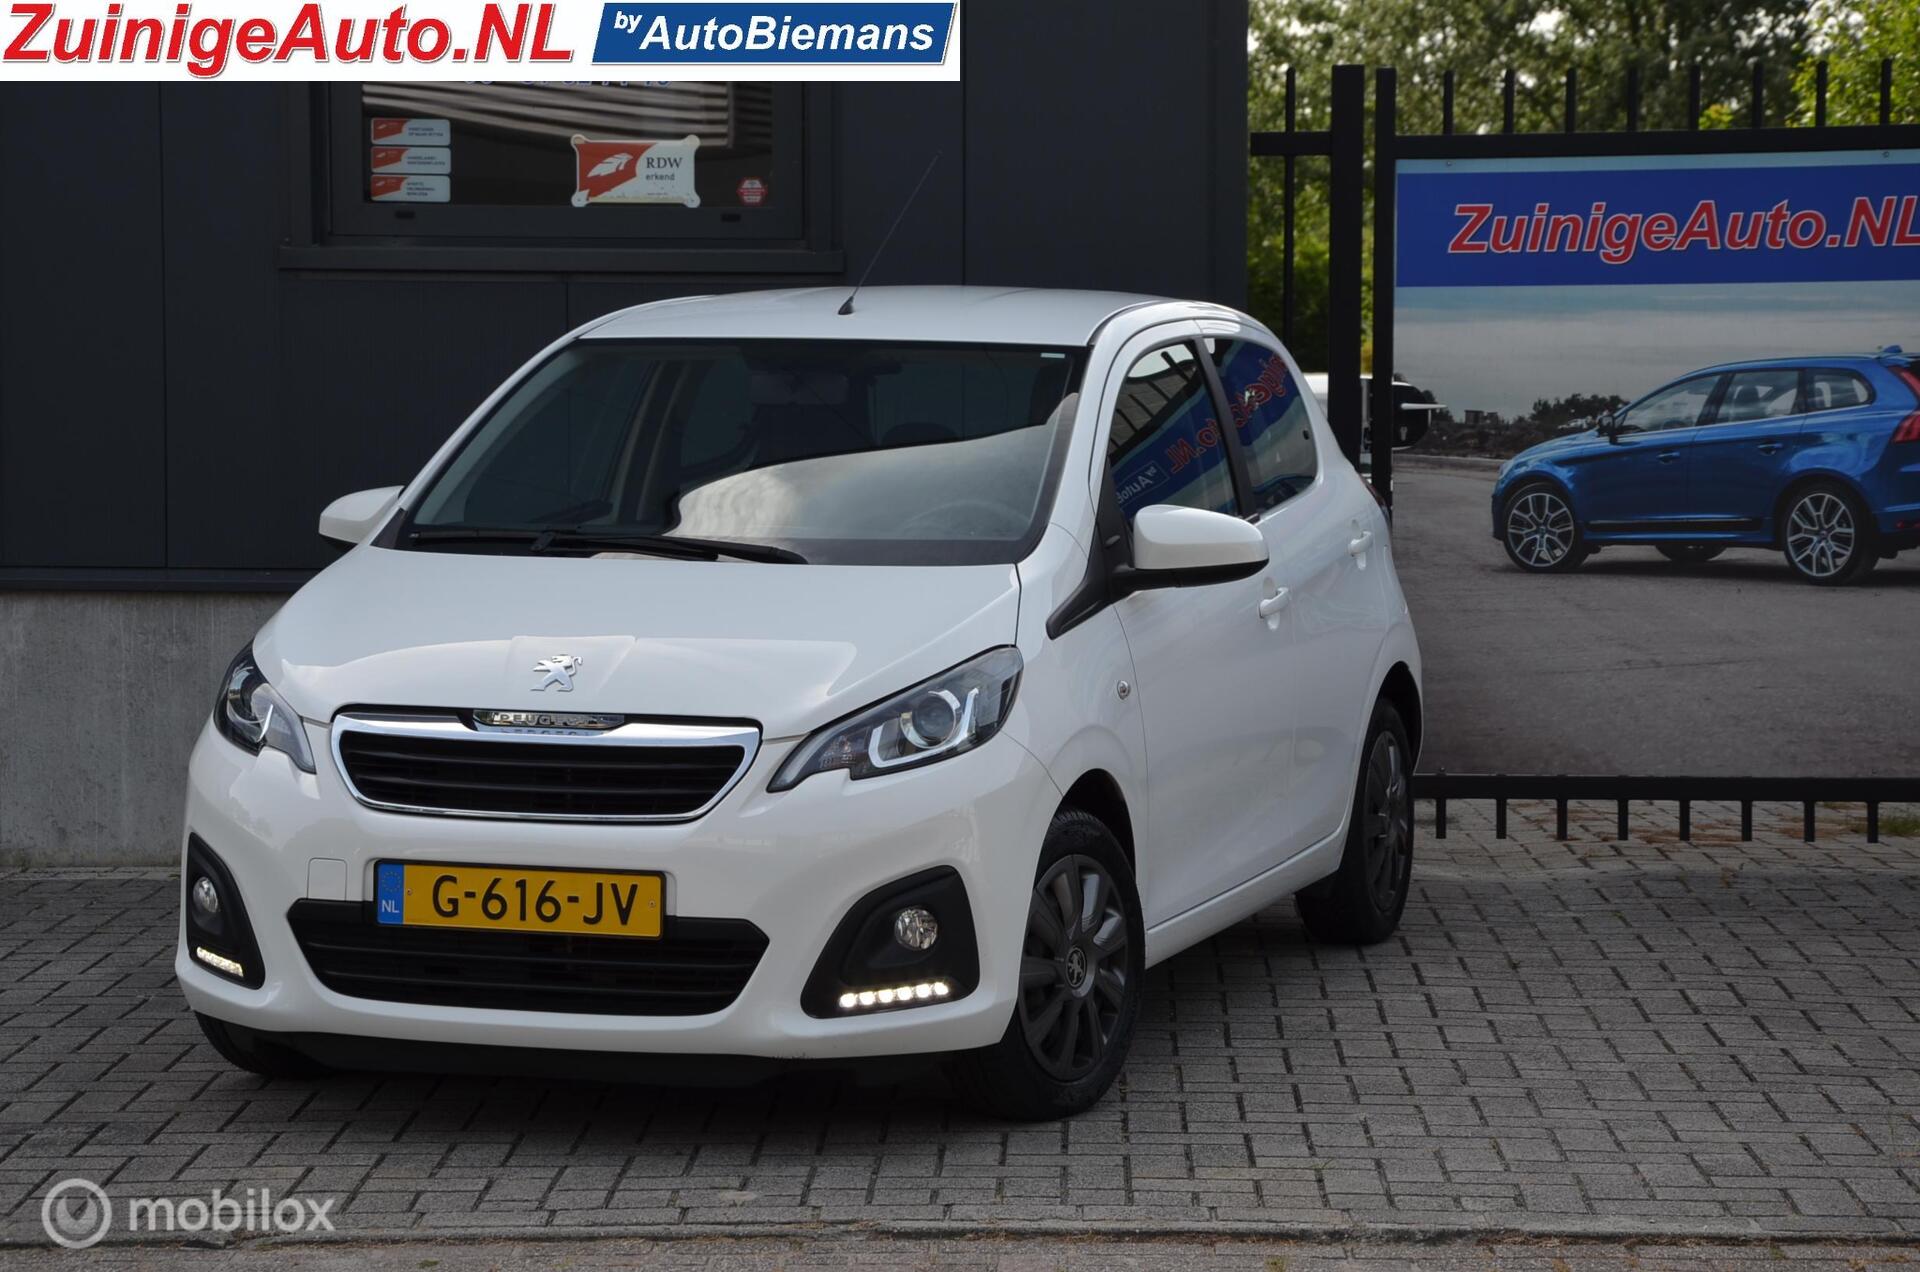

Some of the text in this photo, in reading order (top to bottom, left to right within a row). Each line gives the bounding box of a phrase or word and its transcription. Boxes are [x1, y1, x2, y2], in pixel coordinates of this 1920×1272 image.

[646, 156, 683, 169] RDW
[645, 173, 676, 181] erkend
[1447, 195, 1920, 264] ZuinigeAuto.NL
[499, 713, 596, 728] PEUG
[381, 899, 400, 914] NL
[432, 874, 639, 926] G-616-JV
